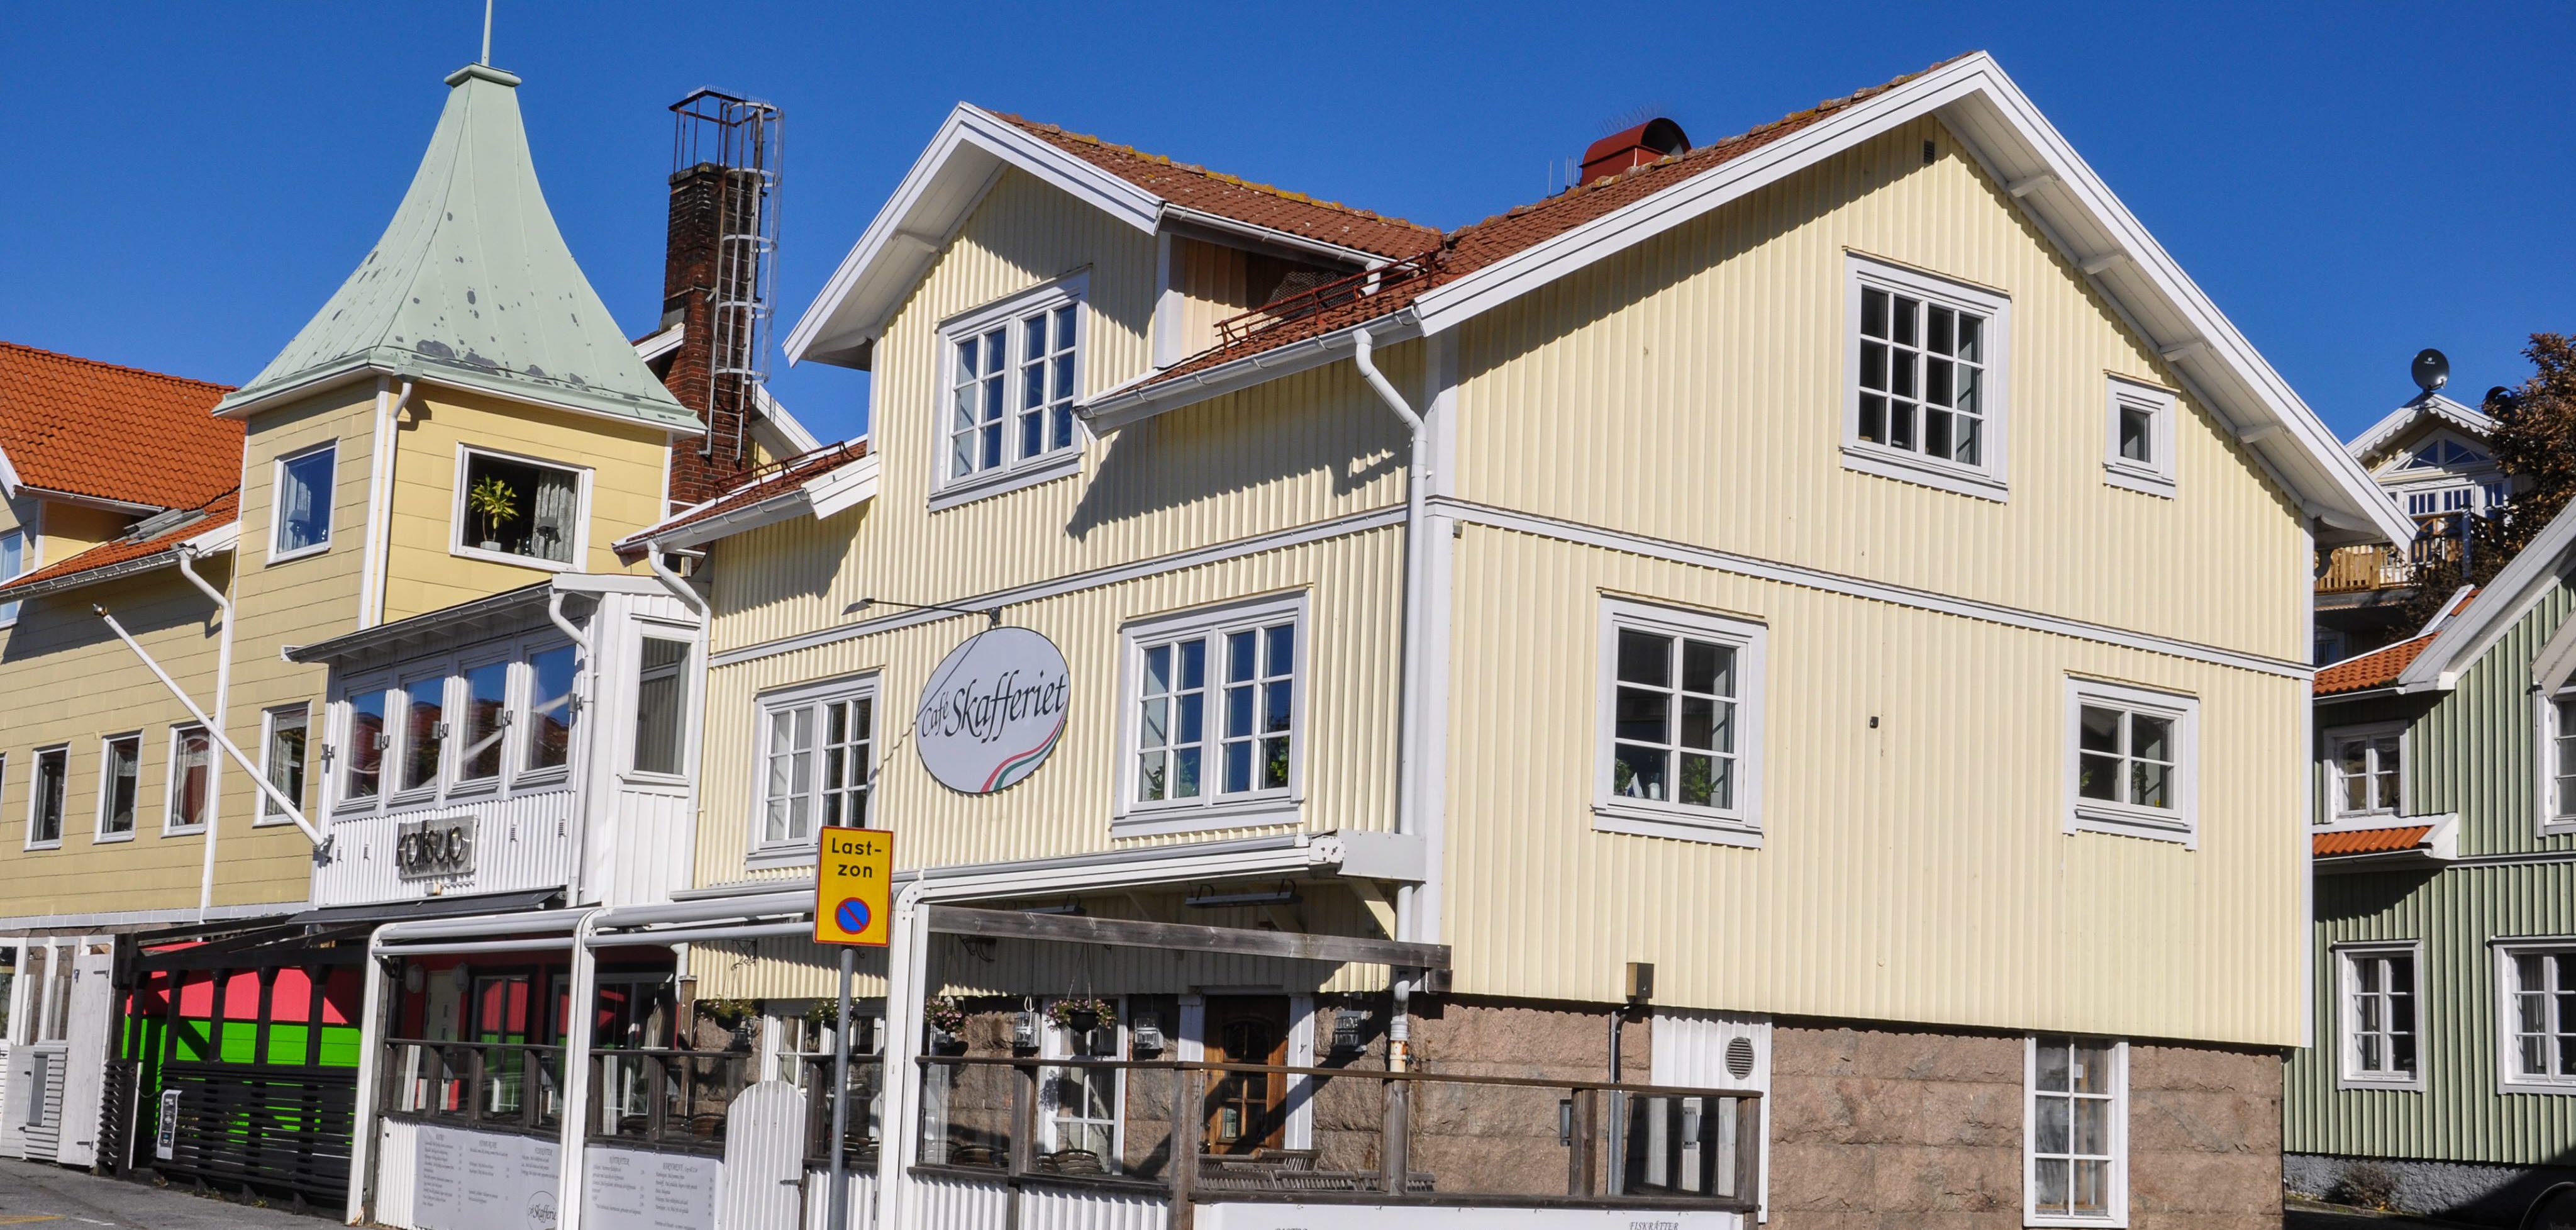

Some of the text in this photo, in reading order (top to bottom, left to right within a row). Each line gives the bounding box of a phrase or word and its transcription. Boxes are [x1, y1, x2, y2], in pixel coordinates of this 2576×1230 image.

[921, 669, 1067, 744] Café Skafferiet
[831, 837, 882, 856] Last-
[838, 864, 872, 878] zon
